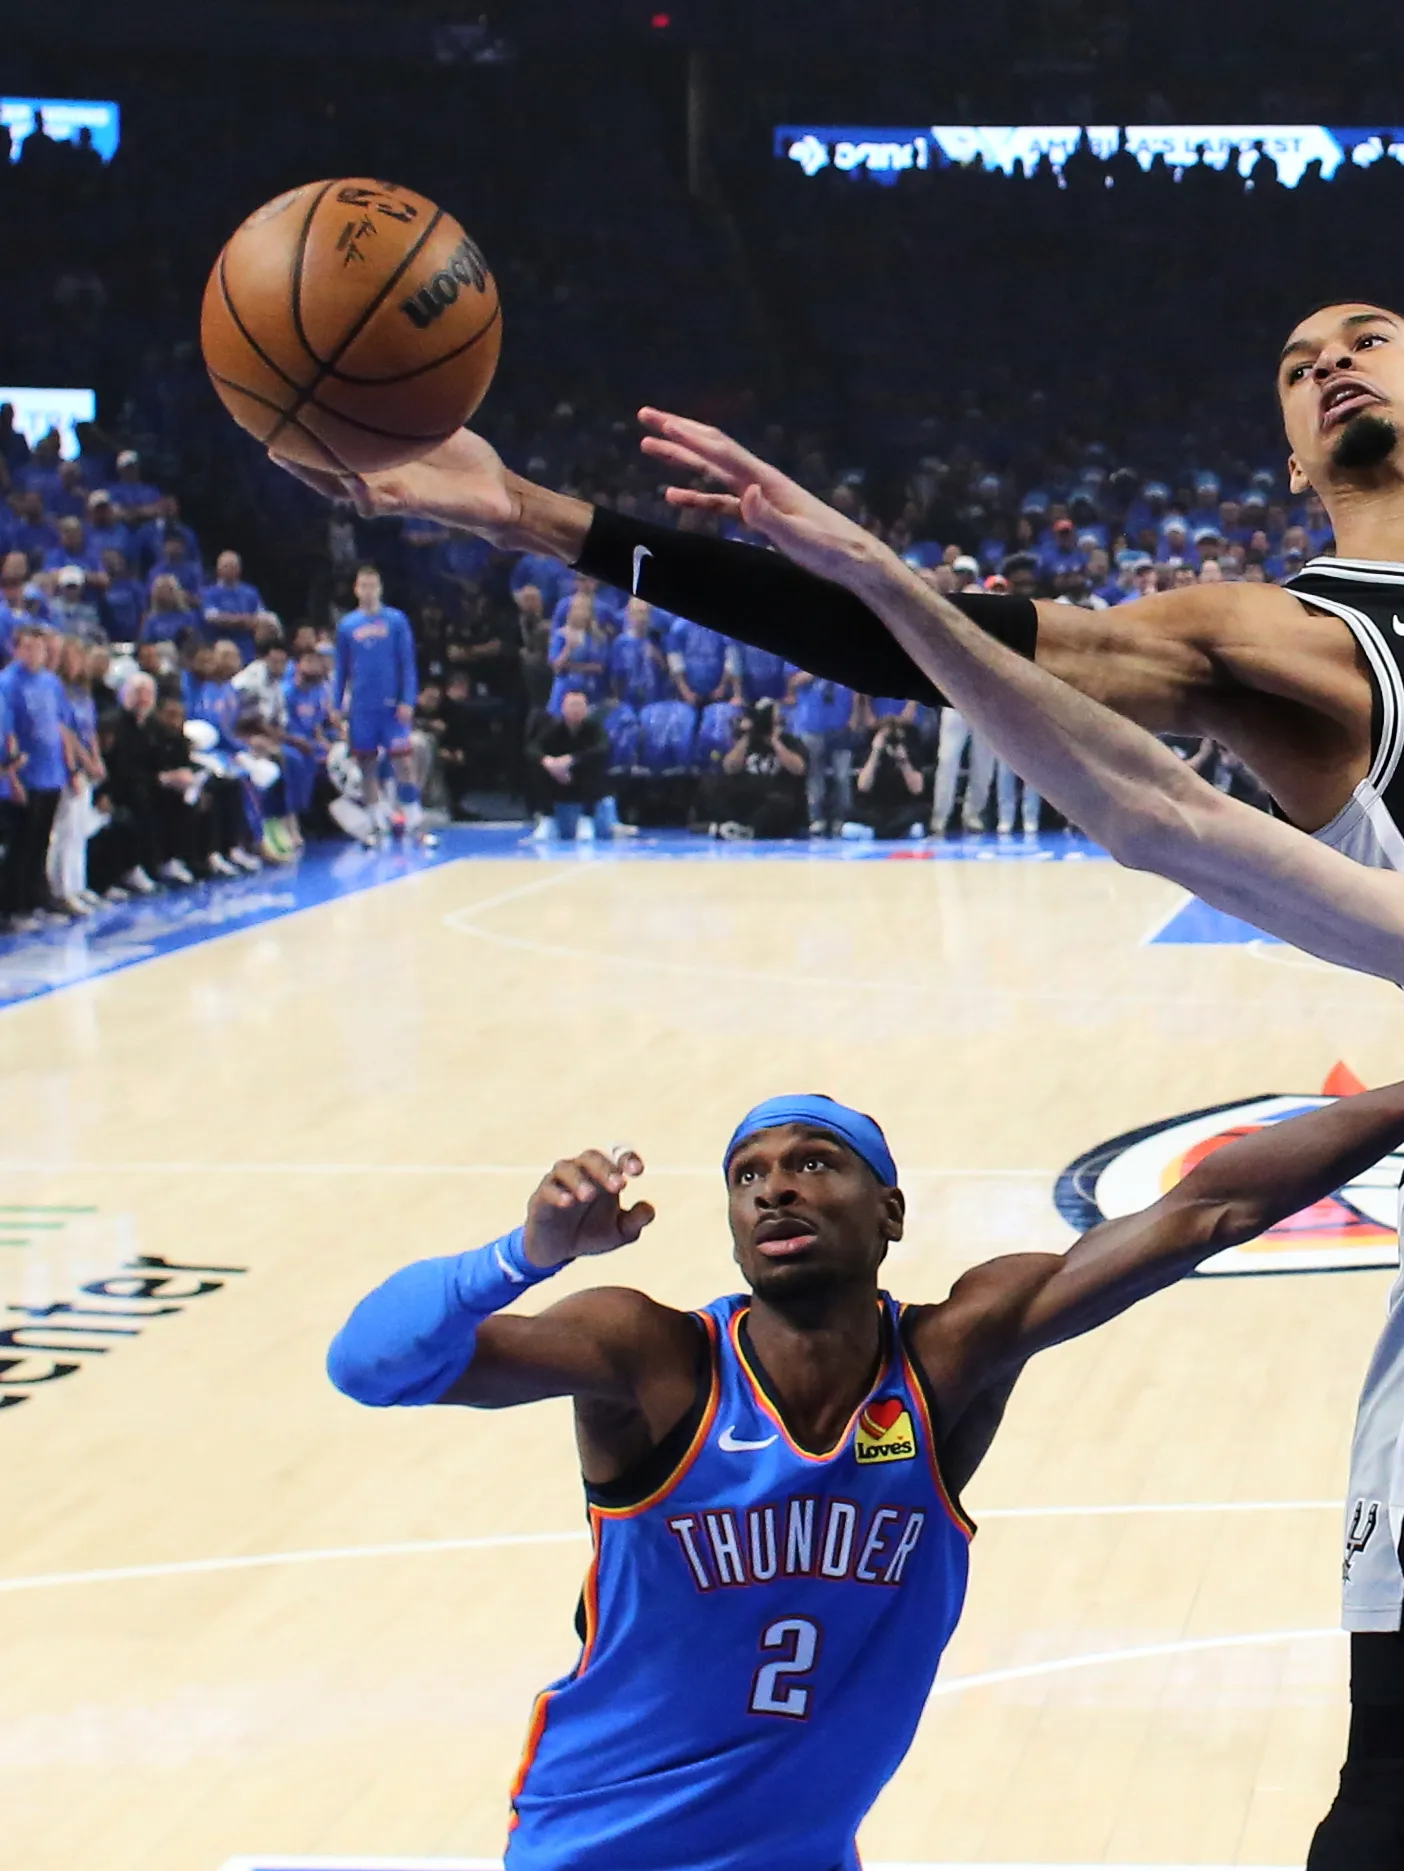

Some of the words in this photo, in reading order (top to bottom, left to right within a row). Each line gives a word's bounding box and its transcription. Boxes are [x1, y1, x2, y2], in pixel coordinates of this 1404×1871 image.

[0, 1254, 250, 1411] enter
[665, 1495, 927, 1593] THUNDER
[746, 1613, 823, 1722] 2
